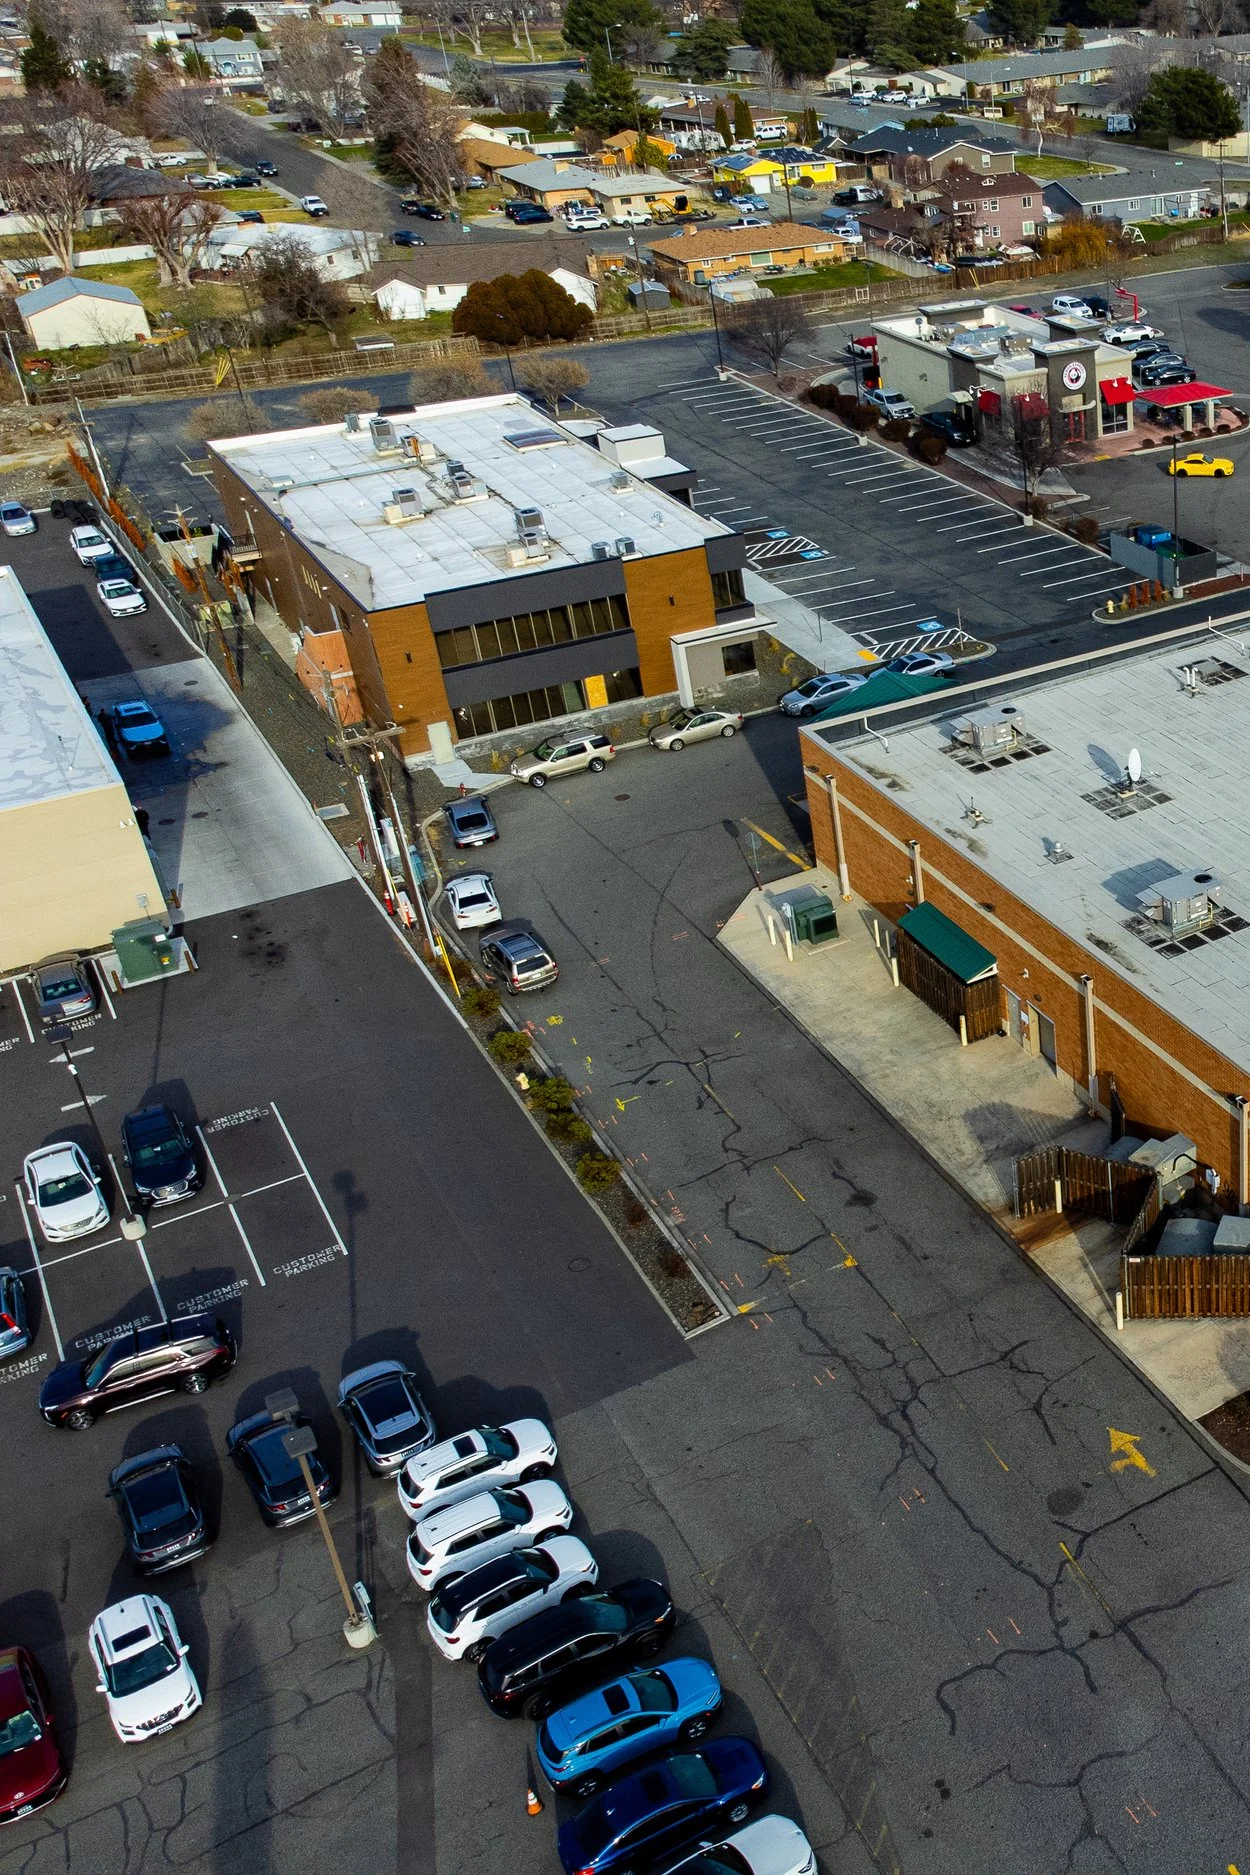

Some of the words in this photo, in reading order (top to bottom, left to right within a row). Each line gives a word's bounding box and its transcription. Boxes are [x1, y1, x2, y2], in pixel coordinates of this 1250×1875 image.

[206, 1110, 269, 1133] CUSTOMER
[213, 1107, 258, 1124] PARKING
[273, 1244, 342, 1274] CUSTOMER
[285, 1254, 335, 1277] PARKING
[177, 1279, 249, 1310] CUSTOMER
[188, 1290, 242, 1314] PARKING
[75, 1315, 152, 1348] CUSTOMER
